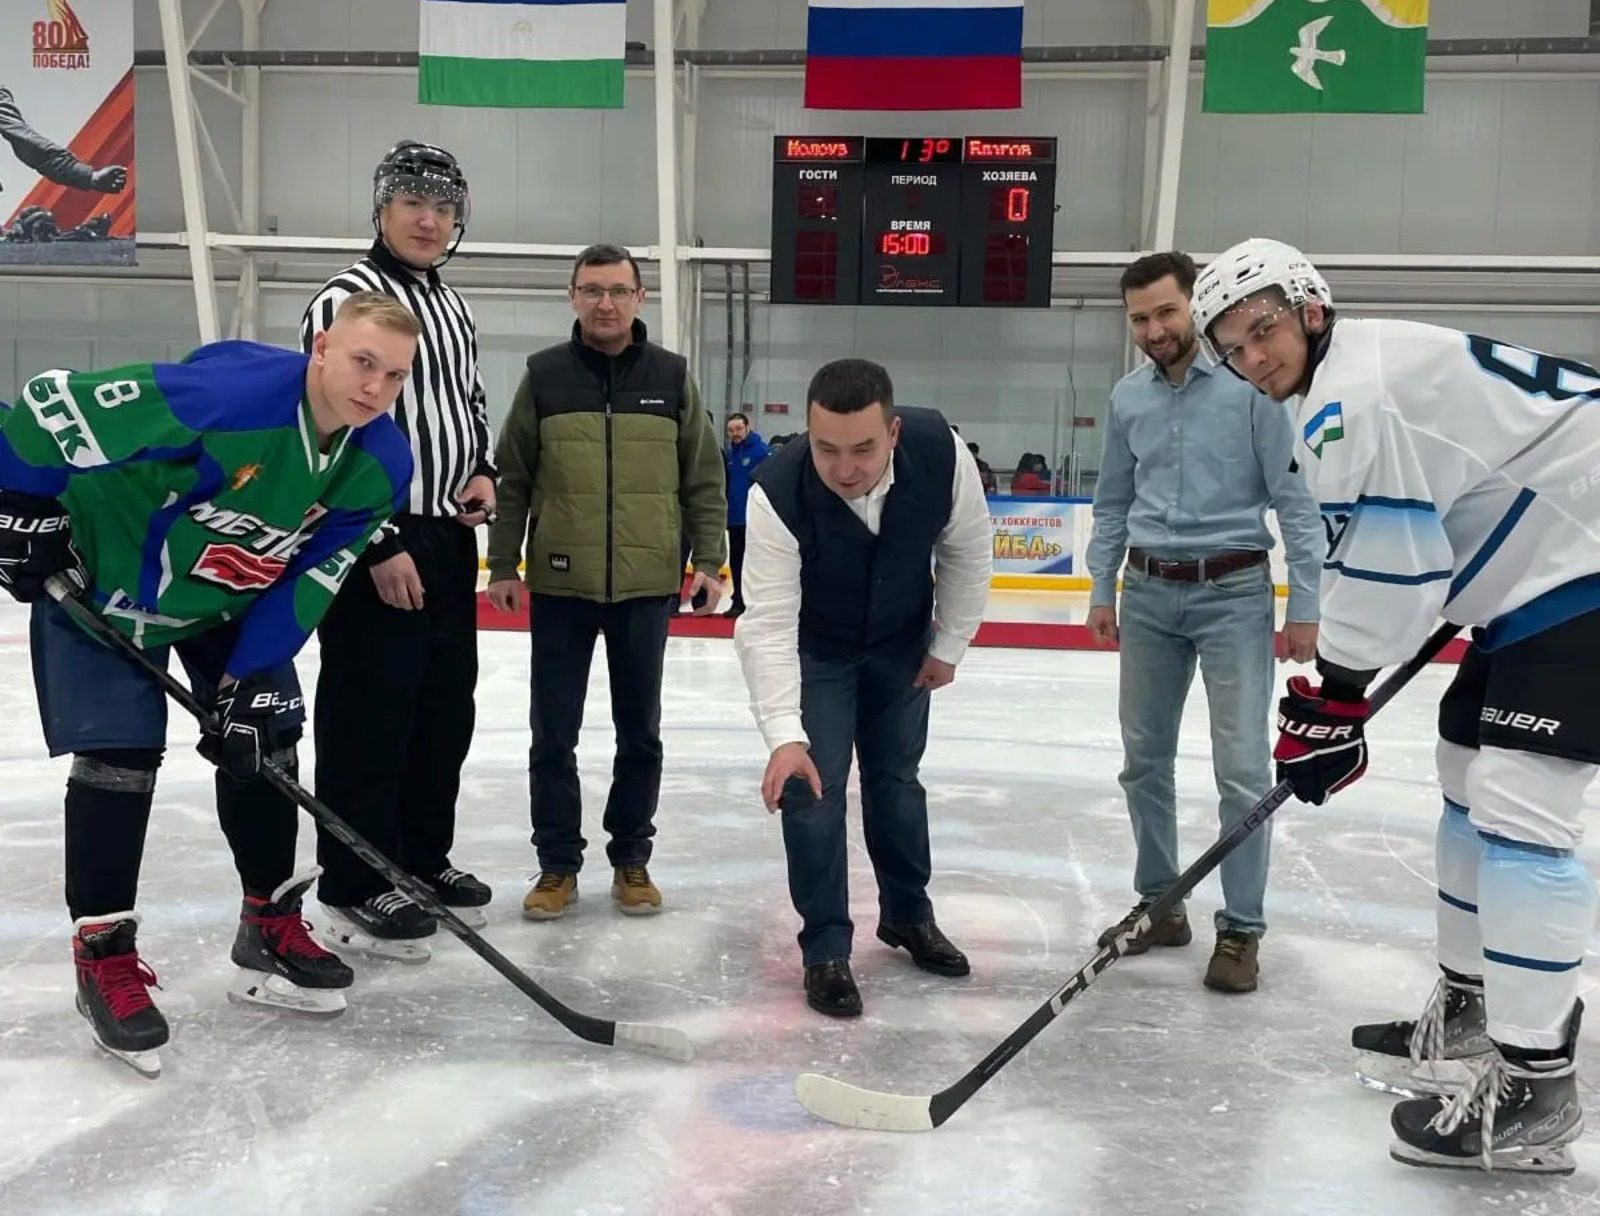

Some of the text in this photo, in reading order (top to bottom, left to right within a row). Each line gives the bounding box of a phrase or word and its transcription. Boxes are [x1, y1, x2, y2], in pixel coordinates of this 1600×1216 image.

[32, 54, 91, 70] ПОБЕДА!
[799, 169, 838, 180] ГОСТИ
[891, 175, 938, 187] ПЕРИОД
[982, 171, 1038, 182] ХОЗЯЕВА
[1008, 188, 1029, 222] 0
[890, 220, 932, 231] ВРЕМЯ
[883, 232, 931, 255] 15:00
[1197, 279, 1221, 302] CCM
[93, 379, 141, 409] 8
[28, 376, 92, 462] БГК
[0, 514, 71, 533] AUER
[1278, 714, 1354, 740] AUER
[1050, 912, 1152, 1015] CCM
